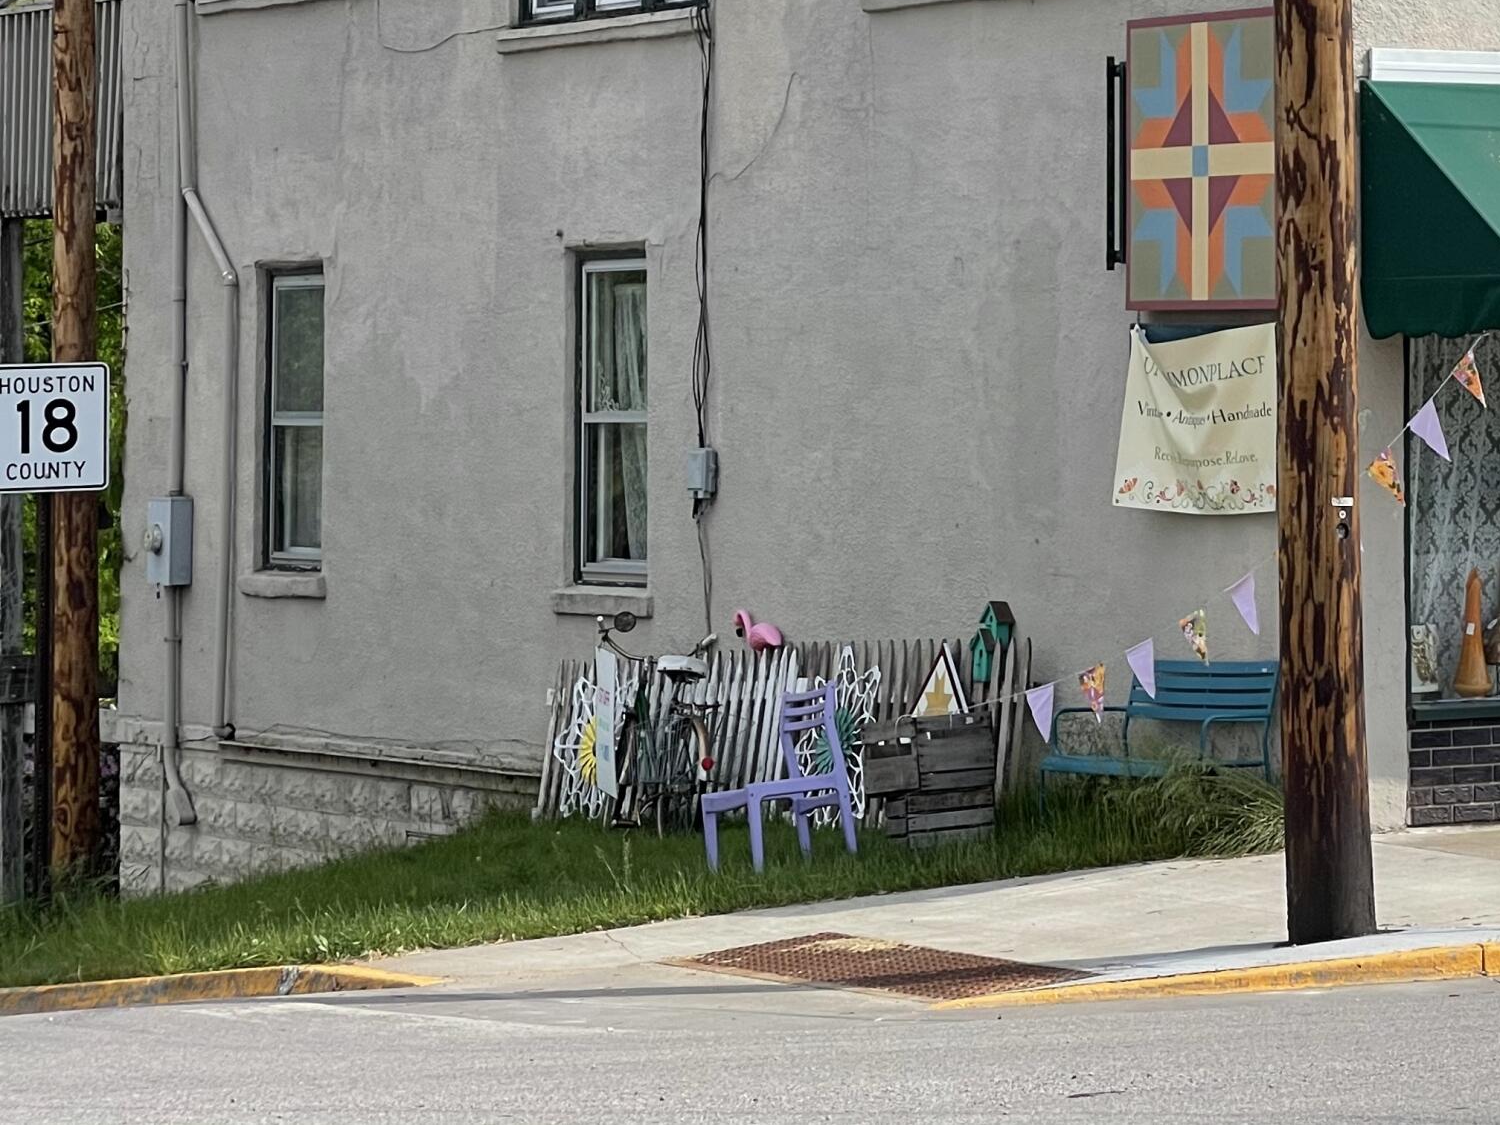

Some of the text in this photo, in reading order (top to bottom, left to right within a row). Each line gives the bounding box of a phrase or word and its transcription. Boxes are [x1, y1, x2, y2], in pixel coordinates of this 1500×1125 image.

[0, 375, 95, 394] HOUSTON
[16, 398, 79, 454] 18
[6, 461, 87, 481] COUNTY
